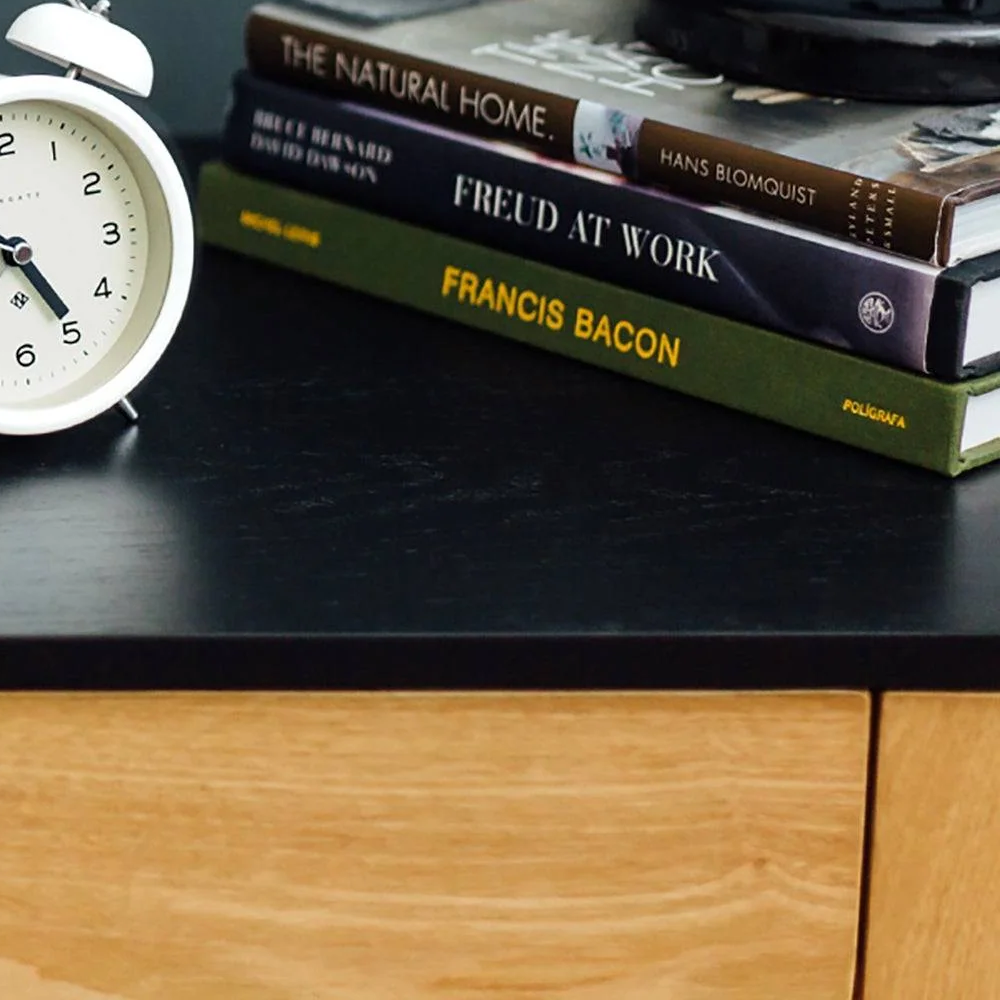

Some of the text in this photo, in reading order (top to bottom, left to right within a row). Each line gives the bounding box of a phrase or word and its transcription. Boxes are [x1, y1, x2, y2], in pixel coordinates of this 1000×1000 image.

[281, 35, 328, 76] THE
[335, 51, 451, 113] NATURAL
[50, 140, 57, 161] 1
[82, 171, 102, 195] 2
[660, 148, 818, 206] HANS BLOMQUIST
[102, 221, 121, 245] 3
[453, 173, 721, 284] FREUD AT WORK
[93, 276, 112, 299] 4
[441, 264, 681, 369] FRANCIS BACON
[62, 320, 81, 345] 5
[15, 343, 36, 367] 6
